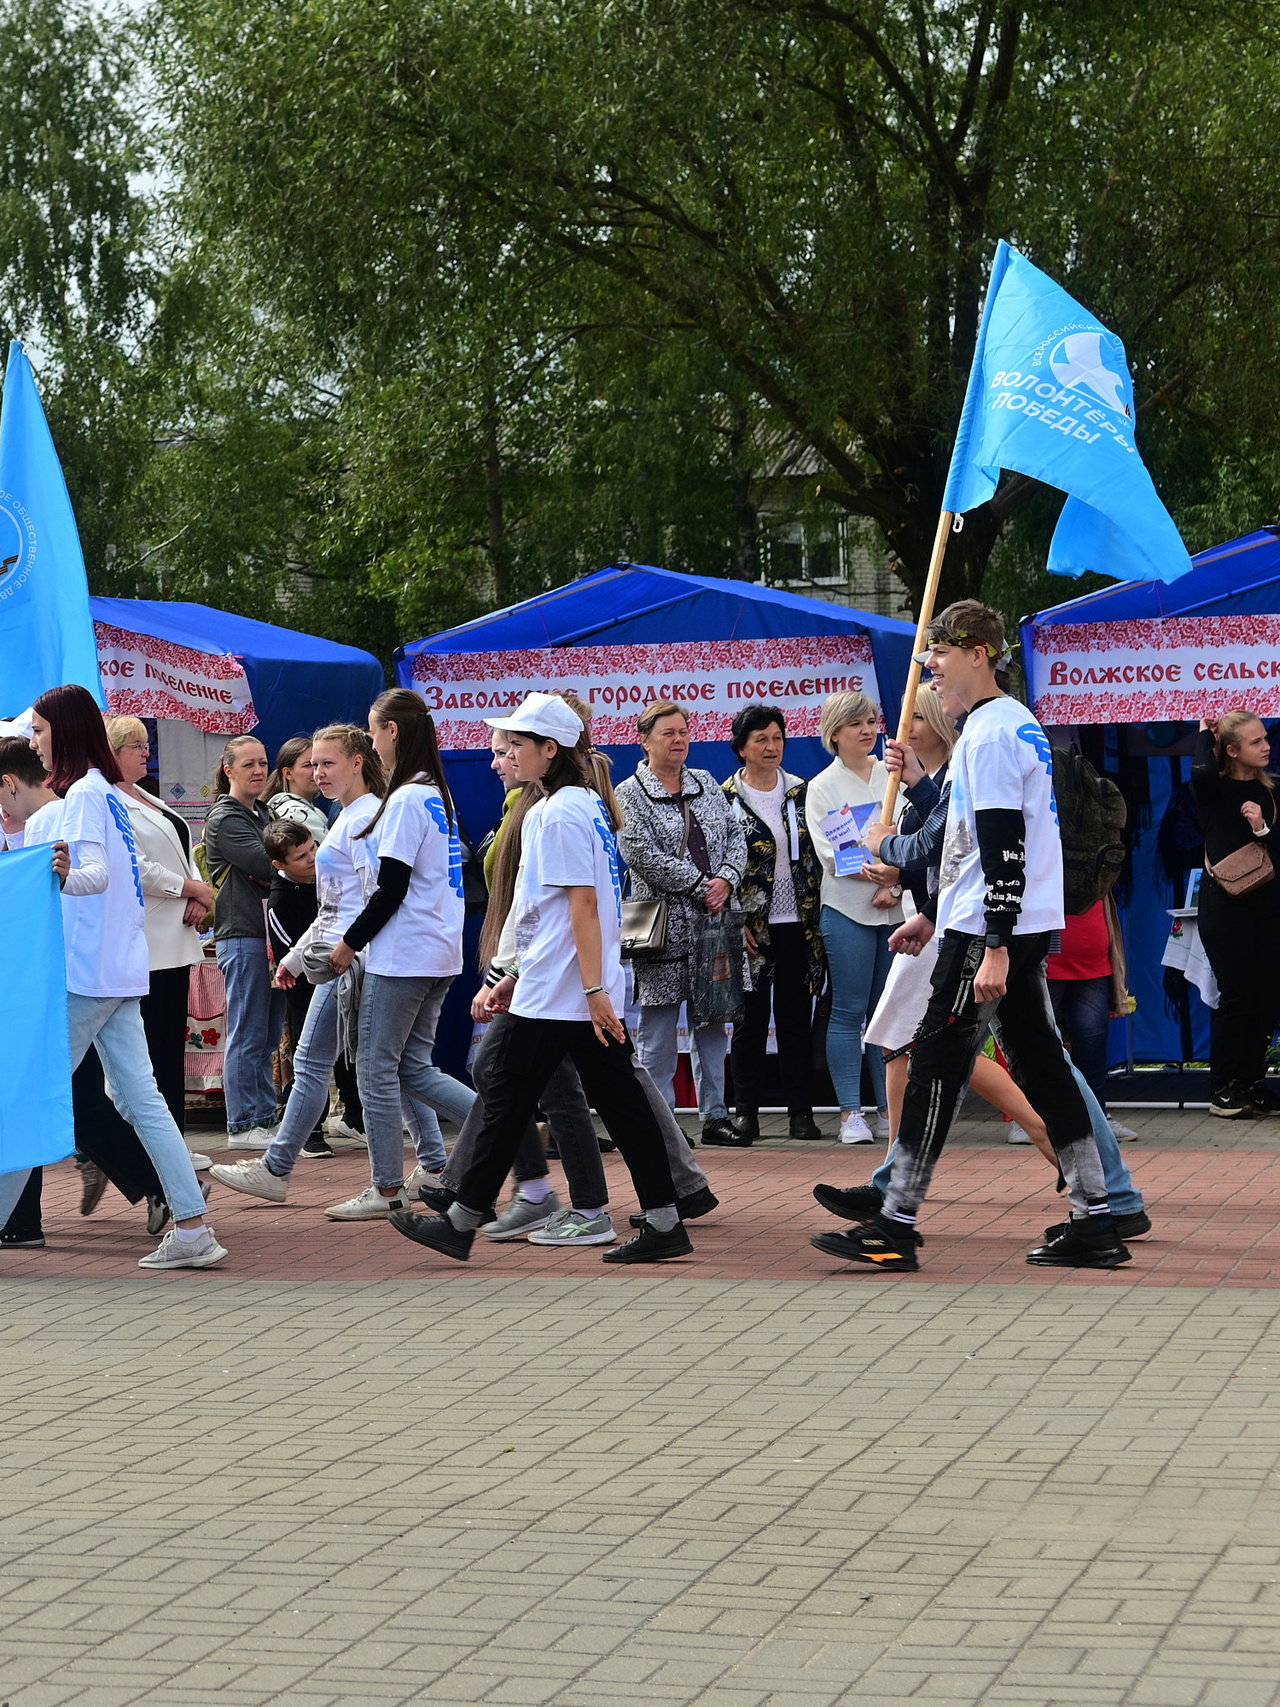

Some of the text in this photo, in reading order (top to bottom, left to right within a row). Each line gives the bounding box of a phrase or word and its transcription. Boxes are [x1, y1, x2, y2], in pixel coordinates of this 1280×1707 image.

[990, 371, 1136, 453] ВОЛОНТЁРЫ
[992, 392, 1102, 444] ПОБЕДЫ
[12, 500, 37, 589] ОБЩЕСТВЕННОЕ
[425, 675, 864, 711] Заволж городское поселение
[1048, 661, 1182, 686] Волжское
